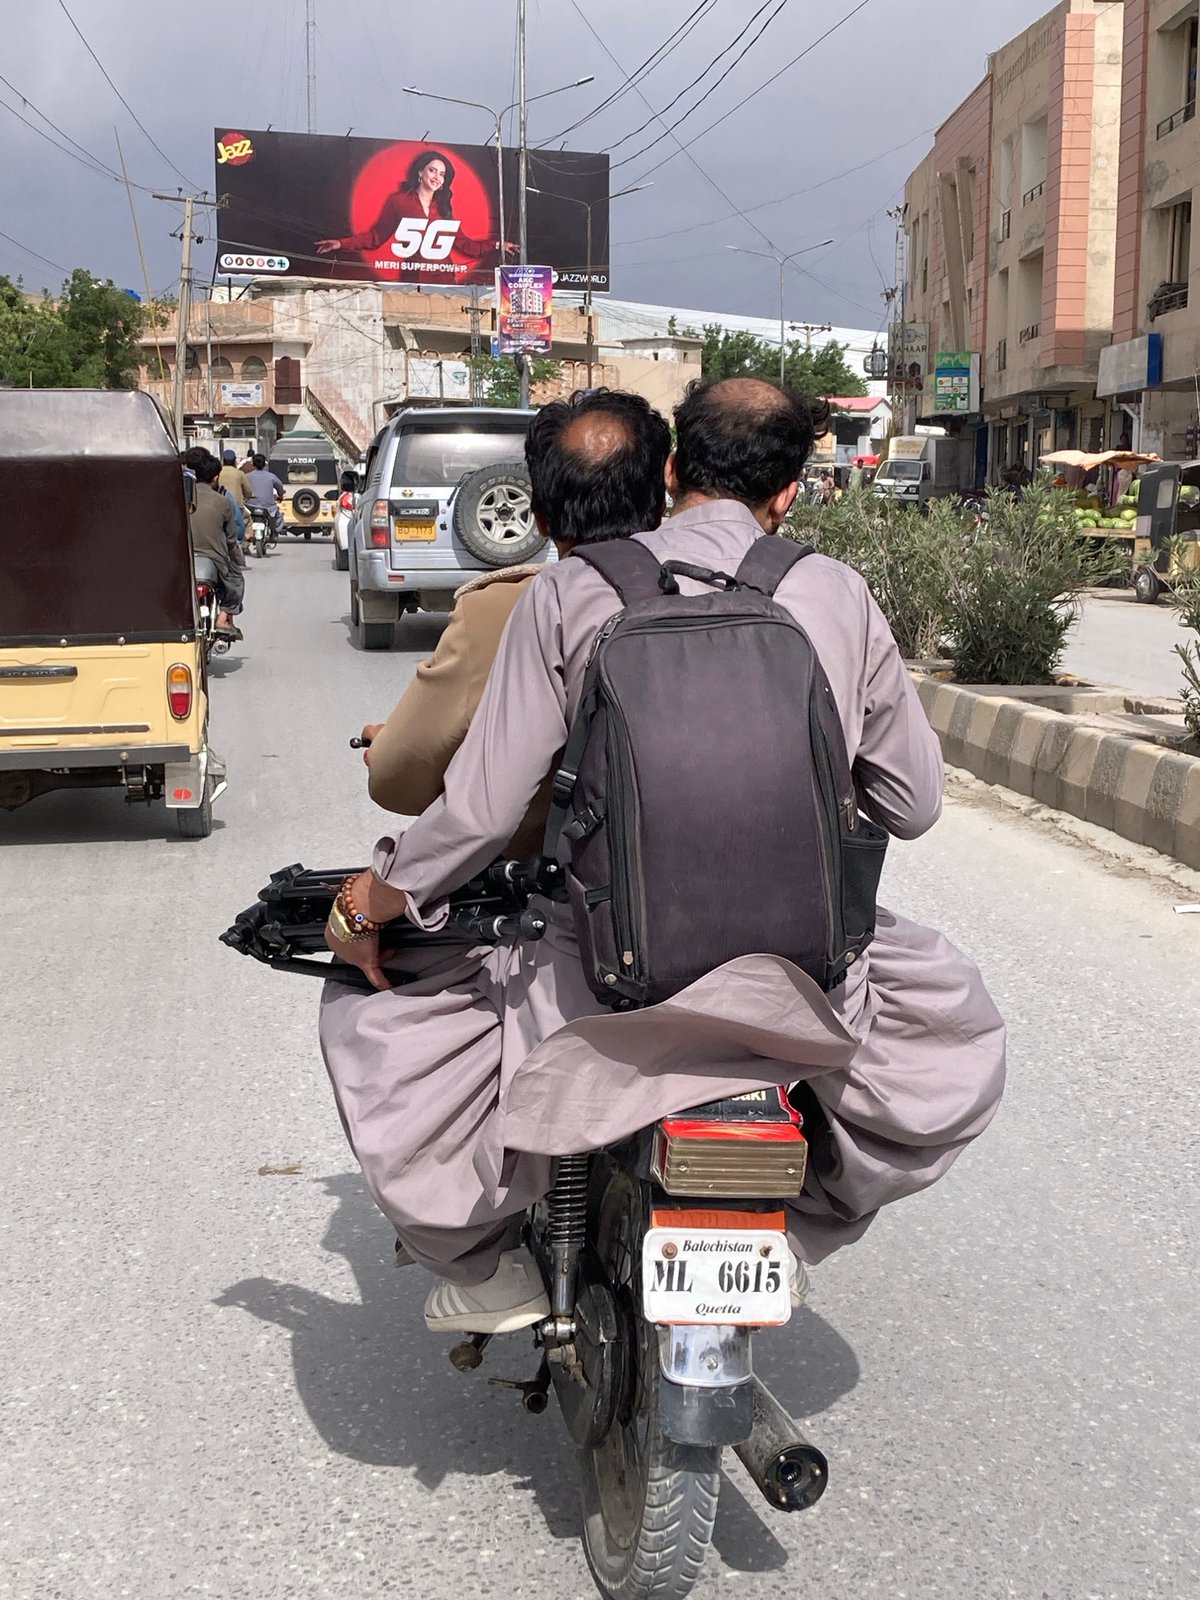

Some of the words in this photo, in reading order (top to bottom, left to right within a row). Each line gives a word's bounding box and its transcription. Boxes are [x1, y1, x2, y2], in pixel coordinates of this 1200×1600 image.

[217, 139, 253, 164] Jazz
[391, 217, 461, 260] 5G
[375, 260, 400, 270] MERI
[682, 1240, 754, 1253] Balochistan
[649, 1260, 694, 1293] ML
[718, 1260, 781, 1293] 6615
[695, 1303, 742, 1316] Quetta
